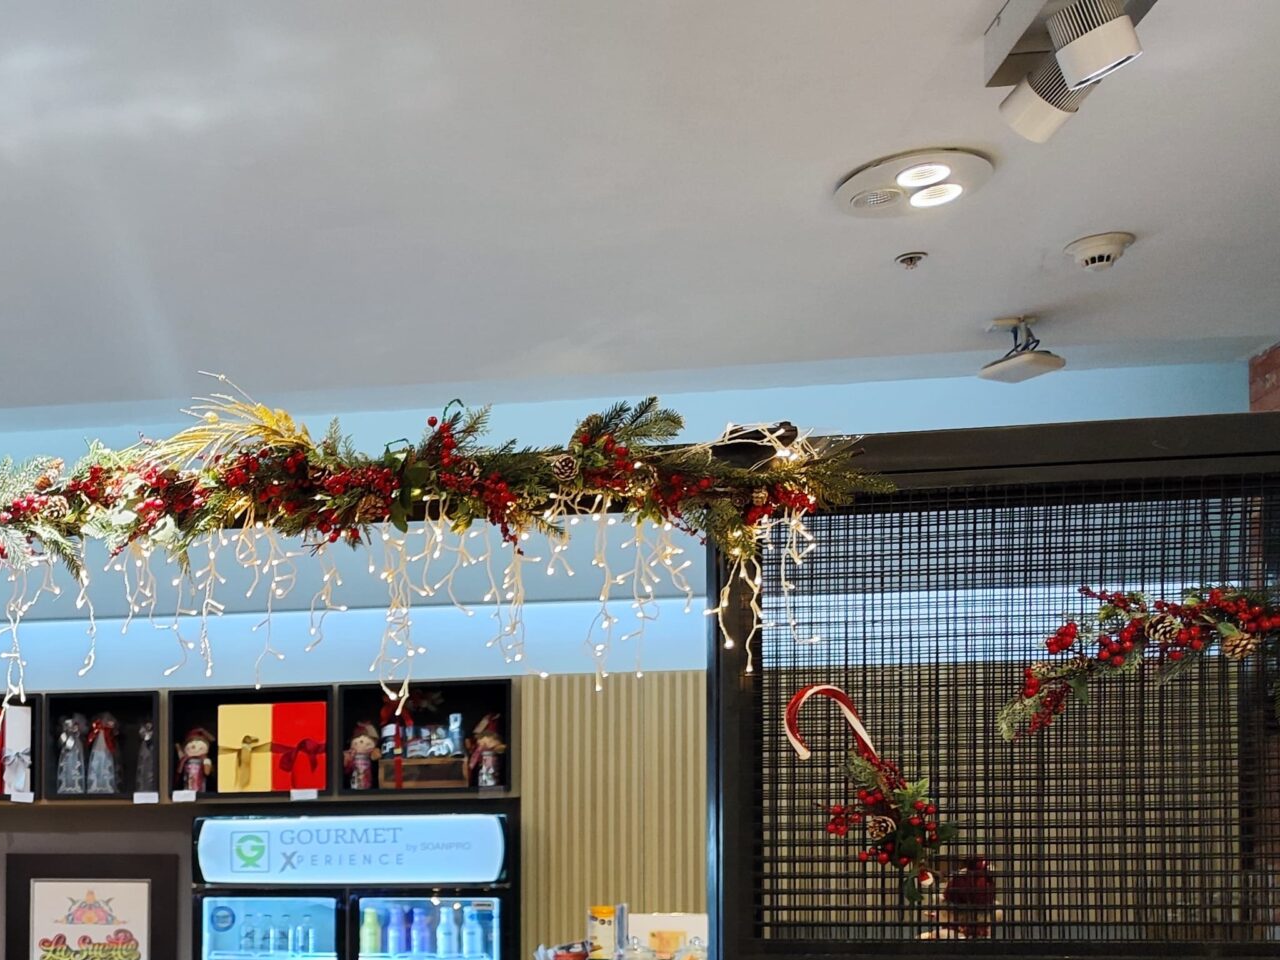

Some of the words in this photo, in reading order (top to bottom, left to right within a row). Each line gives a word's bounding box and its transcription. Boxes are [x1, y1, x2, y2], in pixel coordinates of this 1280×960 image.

[280, 828, 403, 846] GOURMET
[406, 843, 417, 852] by
[420, 842, 470, 851] SOANPRO
[280, 851, 404, 873] XPERIENCE
